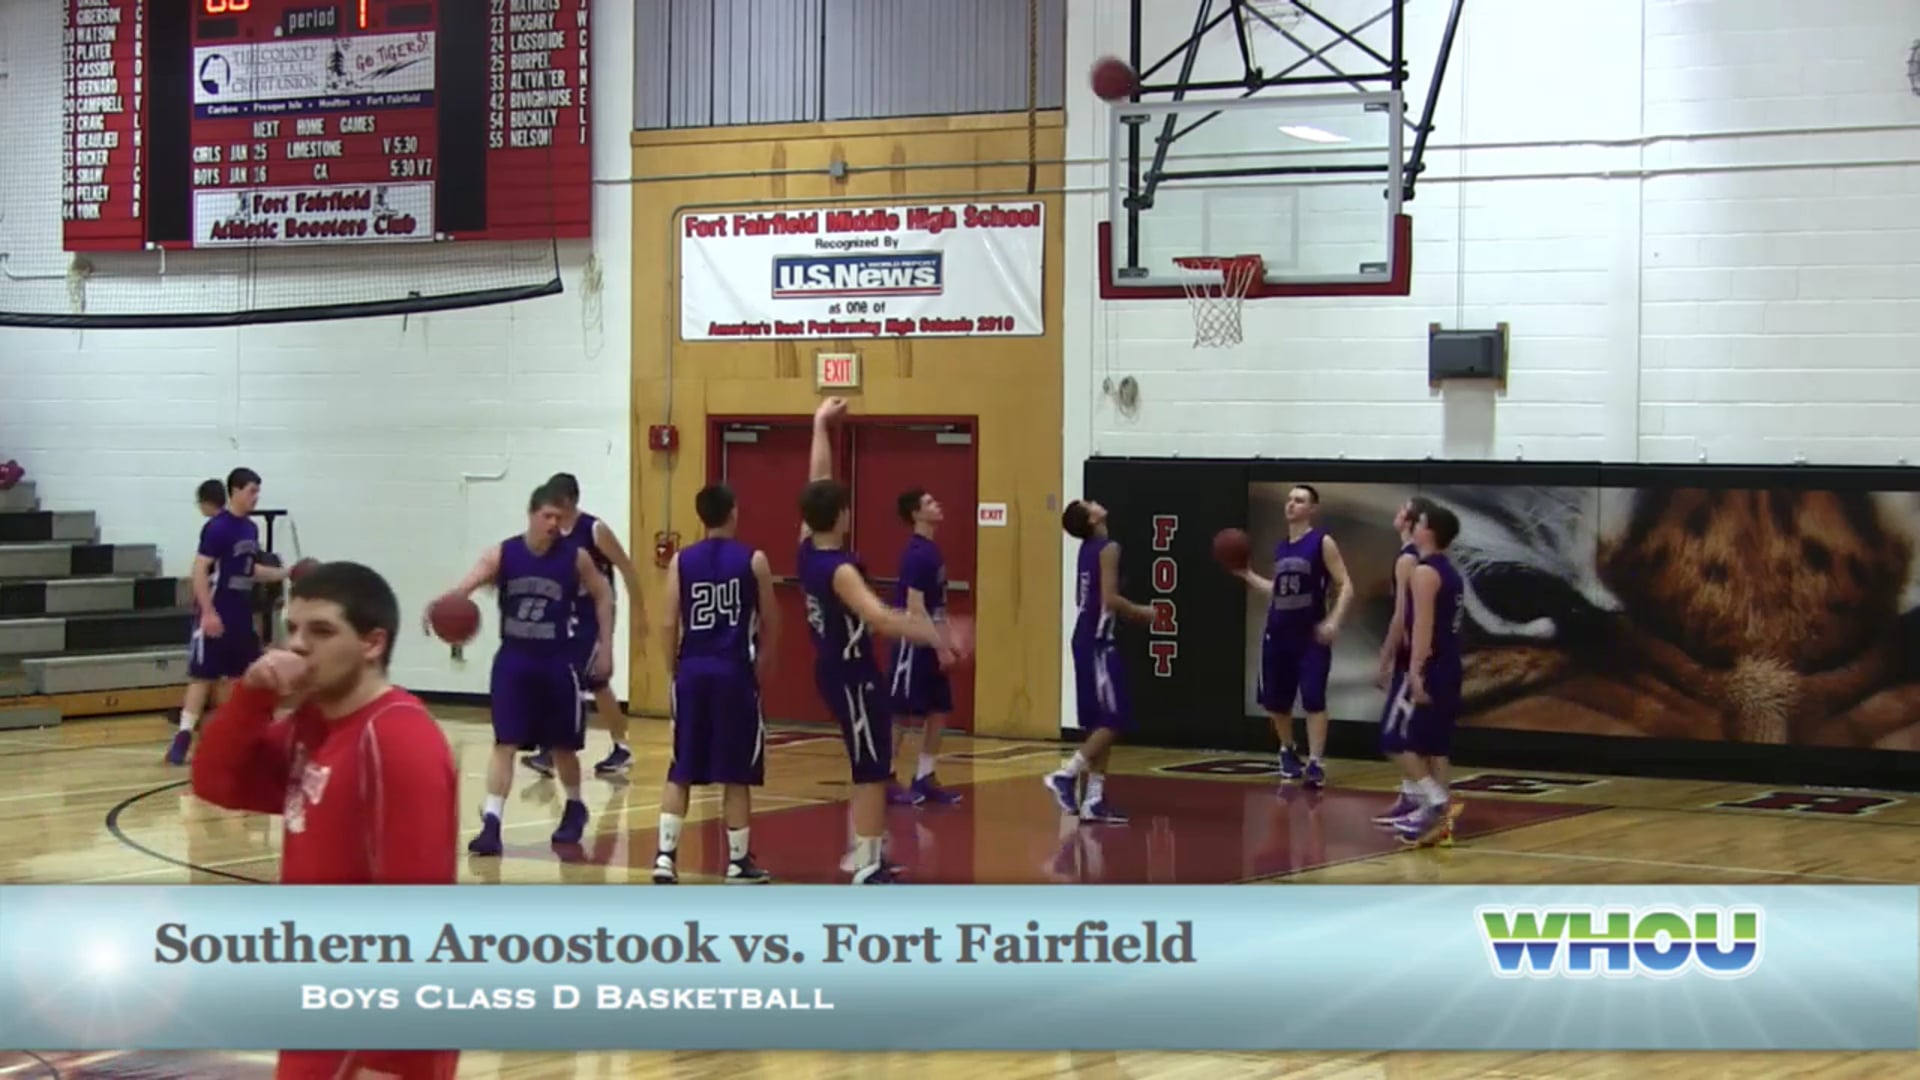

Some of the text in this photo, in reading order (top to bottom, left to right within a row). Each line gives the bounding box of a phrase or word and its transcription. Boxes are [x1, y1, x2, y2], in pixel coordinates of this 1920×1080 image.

[288, 6, 335, 34] period
[491, 10, 588, 34] 23 MCGARY W
[77, 26, 116, 43] WATSON
[491, 34, 504, 53] 24
[580, 29, 587, 47] C
[77, 43, 112, 61] PLAYER
[261, 46, 318, 62] COUNTY
[77, 61, 115, 78] CASSIDY
[491, 54, 504, 73] 25
[77, 78, 118, 97] BERNARD
[491, 73, 504, 92] 33
[77, 96, 123, 114] CAMPBELL
[207, 105, 239, 115] Caribou
[253, 102, 286, 113] Presque
[287, 101, 303, 110] Isle
[367, 96, 385, 105] Fort
[387, 94, 422, 104] Fairfield
[490, 92, 504, 111] 42
[580, 87, 586, 106] E
[77, 114, 105, 132] CRAIG
[253, 116, 376, 138] NEXT HOME GAMES
[490, 111, 504, 130] 54
[580, 107, 586, 125] L
[490, 130, 503, 149] 55
[510, 127, 553, 148] NELSON
[193, 146, 222, 163] GIRLS
[230, 143, 248, 162] JAN
[287, 140, 343, 159] LIMESTONE
[77, 167, 103, 184] SHAW
[193, 168, 220, 186] BOYS
[229, 166, 248, 184] JAN
[313, 162, 329, 180] CA
[253, 189, 372, 215] Fort Fairfield
[210, 213, 417, 240] Athletic Boosters Club
[685, 203, 1041, 238] Fort Fairfield Middle High School
[815, 236, 899, 251] Recognized By
[828, 300, 886, 314] as one of
[708, 316, 1015, 336] America's Best Performing High Schools 2010
[823, 359, 852, 383] EXIT
[980, 508, 1004, 521] EXIT
[690, 577, 741, 631] 24
[1149, 515, 1179, 677] FORT
